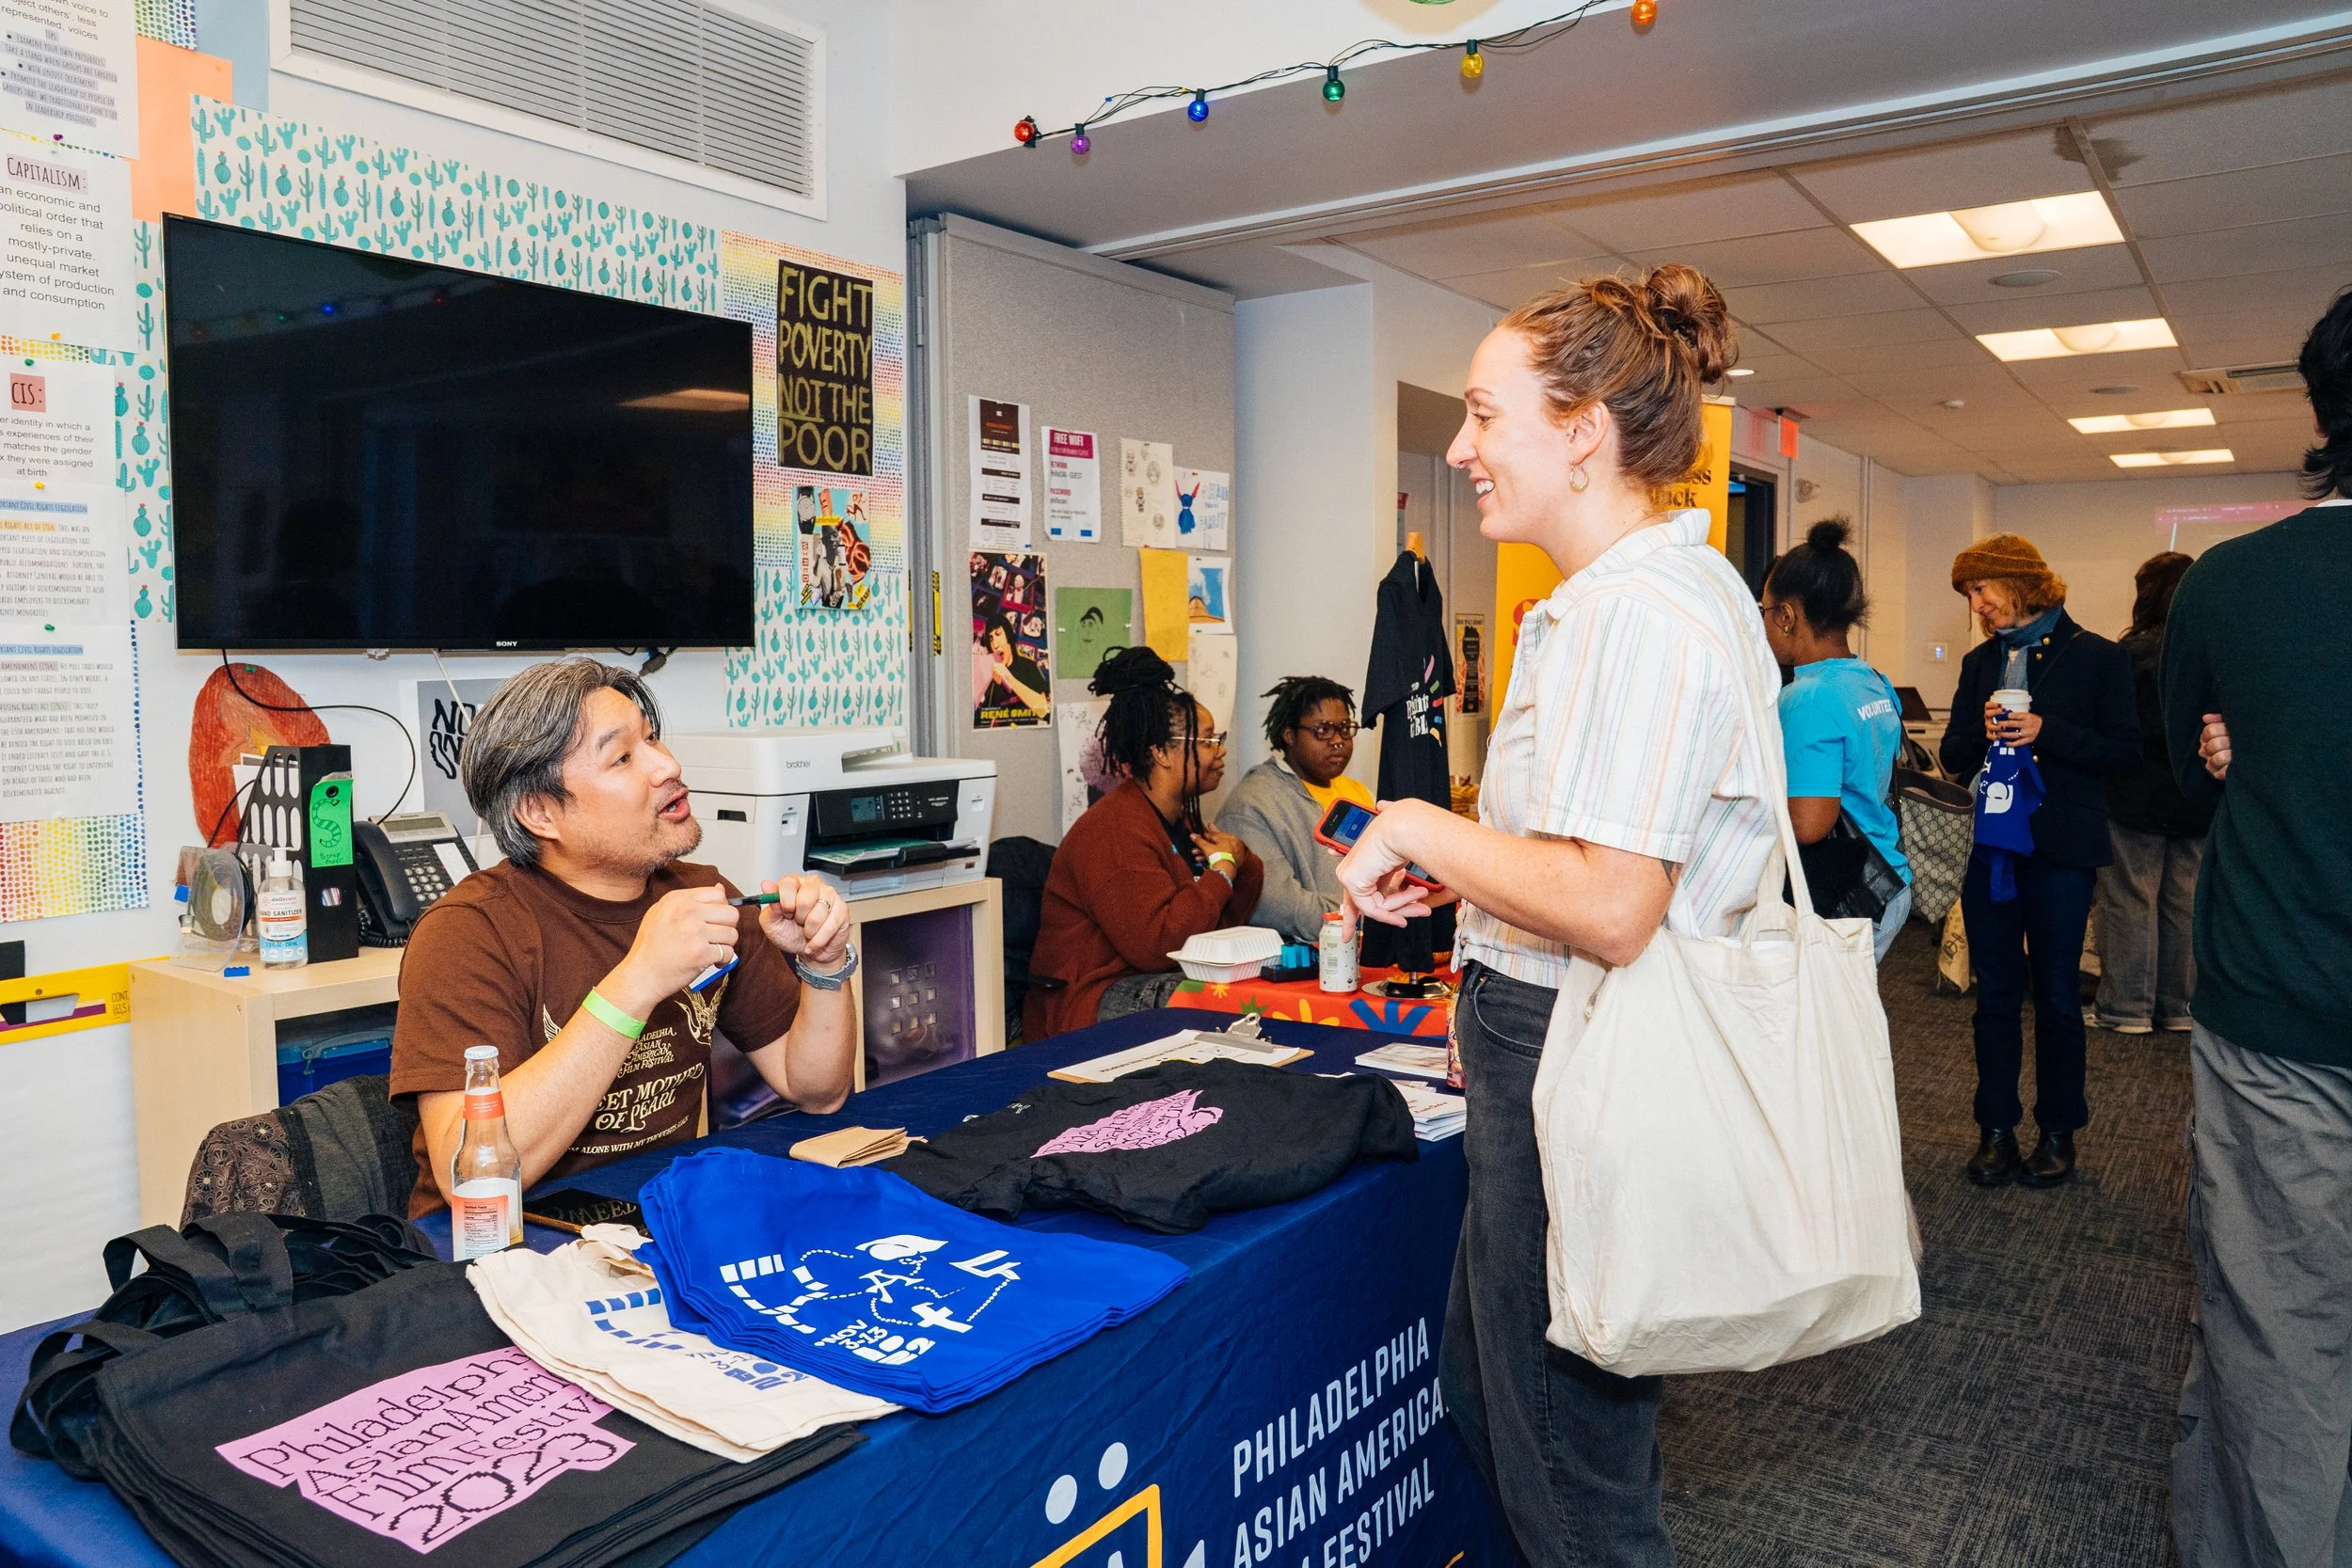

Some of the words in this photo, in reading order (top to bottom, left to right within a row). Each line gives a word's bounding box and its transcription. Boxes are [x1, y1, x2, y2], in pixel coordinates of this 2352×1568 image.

[72, 2, 97, 15] voice
[99, 9, 109, 19] to
[77, 14, 97, 27] less
[68, 26, 98, 40] voices
[16, 189, 75, 209] economic
[79, 201, 101, 213] and
[21, 223, 53, 237] relies
[56, 230, 72, 240] on
[75, 233, 83, 242] a
[46, 212, 78, 225] order
[81, 218, 103, 230] that
[8, 254, 56, 269] unequal
[59, 263, 100, 278] market
[0, 270, 36, 283] ystem
[40, 275, 51, 285] of
[55, 278, 115, 295] production
[3, 287, 26, 298] and
[30, 292, 105, 310] consumption
[779, 265, 873, 328] FIGHT
[779, 320, 873, 380] POVERTY
[11, 382, 43, 405] CIS:
[779, 372, 825, 420] NOT
[828, 381, 871, 425] THE
[11, 418, 43, 429] identity
[56, 421, 83, 431] which
[4, 442, 41, 452] matches
[43, 444, 58, 453] the
[60, 447, 92, 456] gender
[7, 430, 61, 442] experiences
[75, 435, 94, 444] their
[779, 420, 871, 475] POOR
[1054, 433, 1068, 444] FREE
[8, 454, 26, 465] they
[53, 458, 94, 468] assigned
[27, 468, 48, 477] birth
[786, 759, 811, 769] brother
[617, 1063, 641, 1078] FILM
[641, 1052, 675, 1069] FESTIVAL
[595, 1088, 632, 1112] EET
[595, 1110, 628, 1131] OF
[621, 1087, 675, 1133] PEARL
[581, 1145, 610, 1153] ALONE
[611, 1142, 634, 1153] WITH
[634, 1139, 647, 1148] MY
[645, 1127, 676, 1144] THOUGHTS
[822, 1319, 867, 1343] NOV
[838, 1326, 888, 1350] 3-13
[442, 1368, 570, 1436] Ameri
[1232, 1317, 1430, 1497] PHILADELPHIA
[239, 1349, 531, 1481] Philadelphi
[1232, 1465, 1327, 1568] ASIAN
[1338, 1376, 1451, 1504] AMERICA
[320, 1456, 477, 1522] Film
[388, 1432, 618, 1544] 2023
[1323, 1458, 1435, 1568] FESTIVAL
